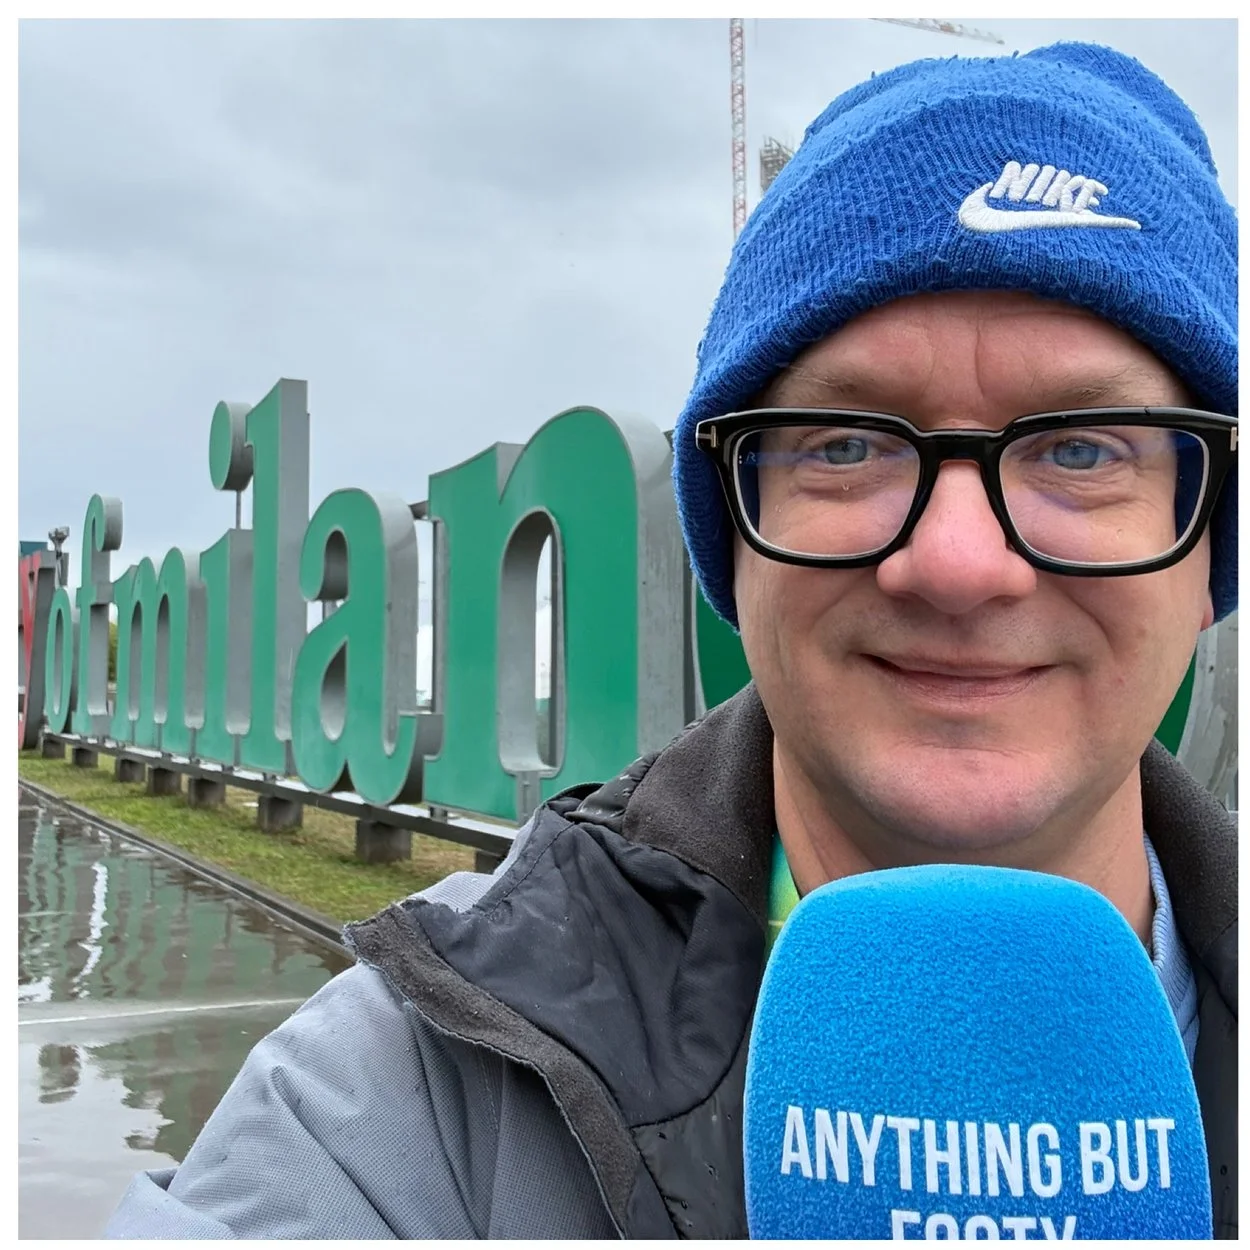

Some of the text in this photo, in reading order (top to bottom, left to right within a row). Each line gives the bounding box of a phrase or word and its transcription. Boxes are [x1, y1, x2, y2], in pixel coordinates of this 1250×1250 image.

[989, 160, 1109, 214] NIKE
[45, 493, 106, 737] of
[111, 378, 745, 820] milan
[781, 1105, 1176, 1198] ANYTHING BUT
